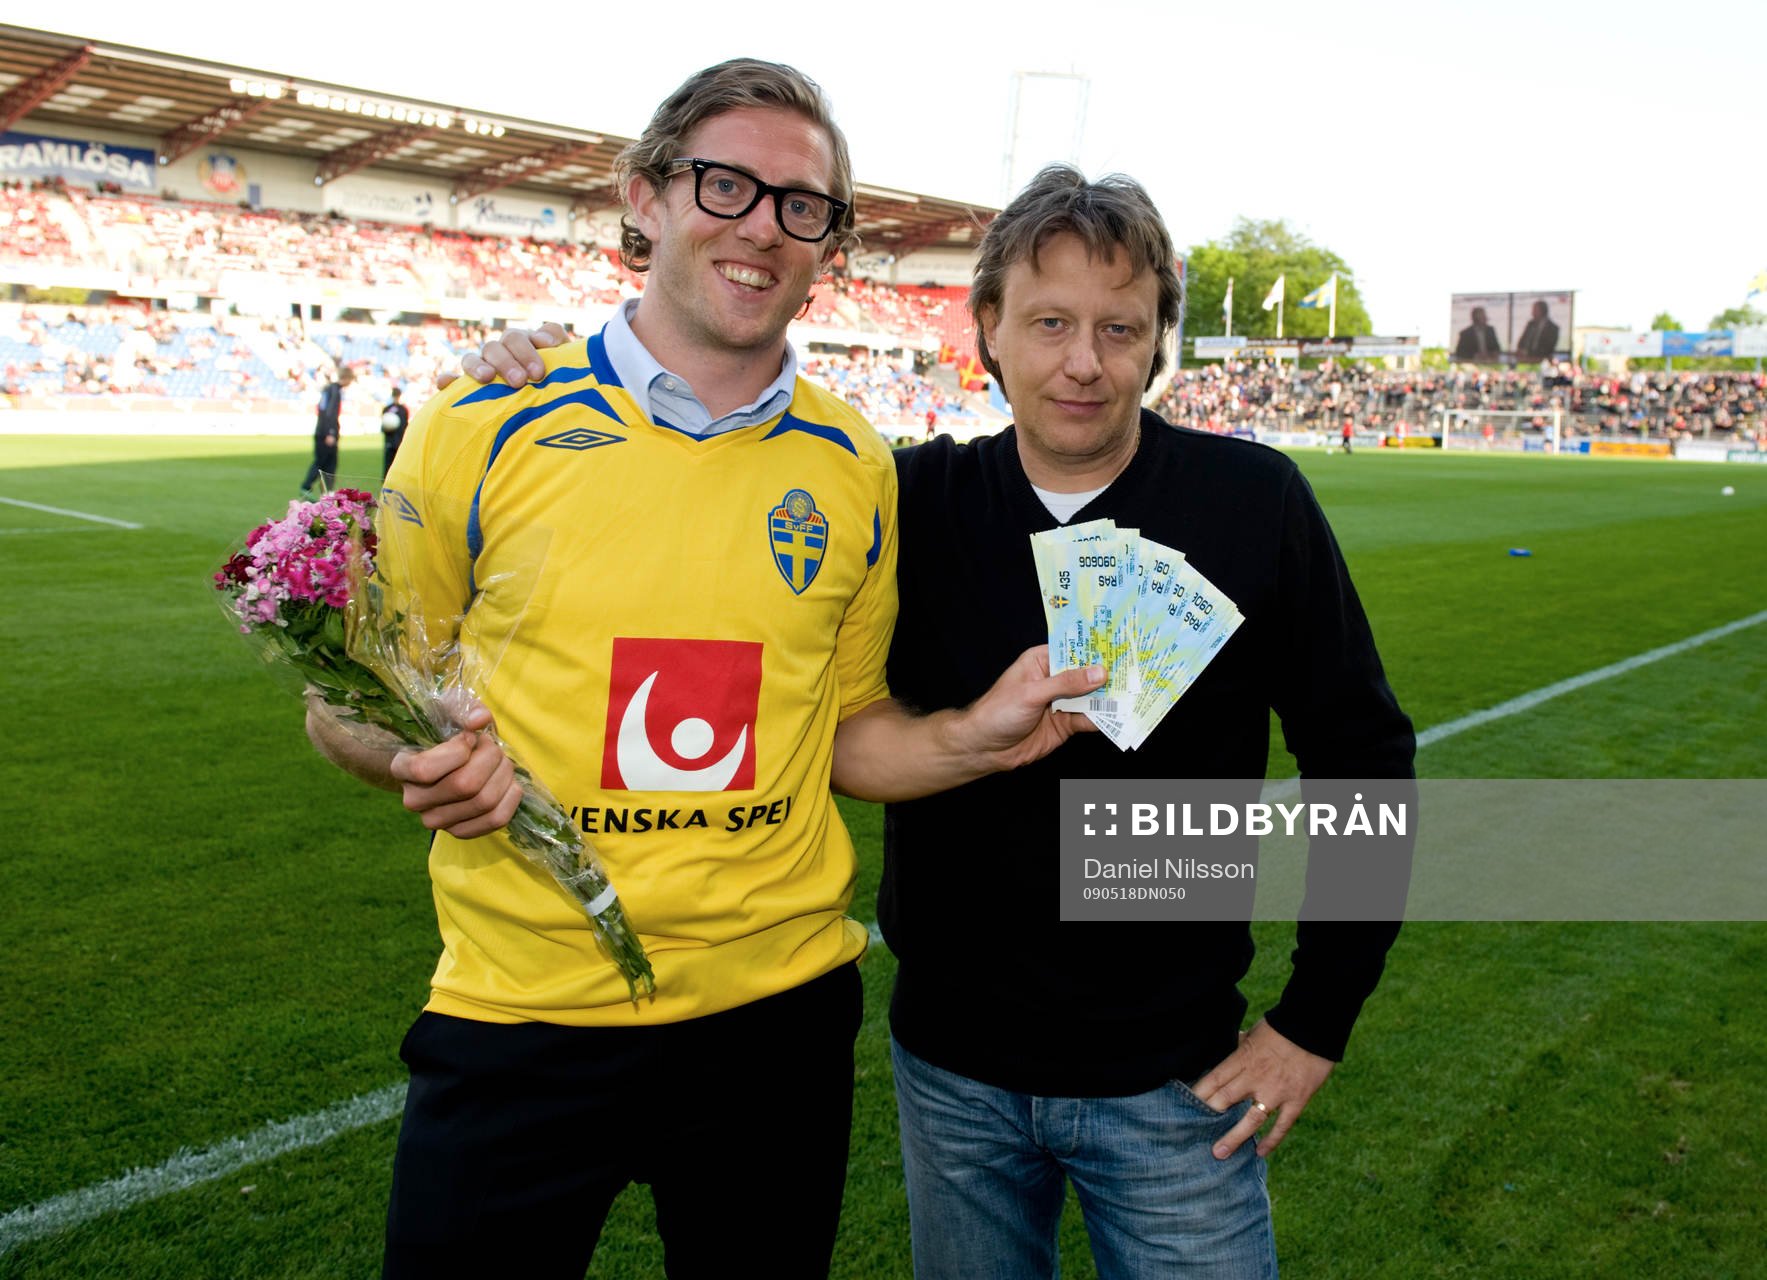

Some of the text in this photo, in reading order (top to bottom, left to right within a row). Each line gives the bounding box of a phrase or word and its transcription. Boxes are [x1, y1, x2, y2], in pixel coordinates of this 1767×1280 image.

[0, 139, 152, 187] RAMLÖSA
[784, 520, 813, 533] SvFF
[1079, 556, 1116, 567] 090606
[1059, 570, 1071, 590] 435
[1098, 575, 1117, 587] RAS
[560, 803, 708, 834] ENSKA
